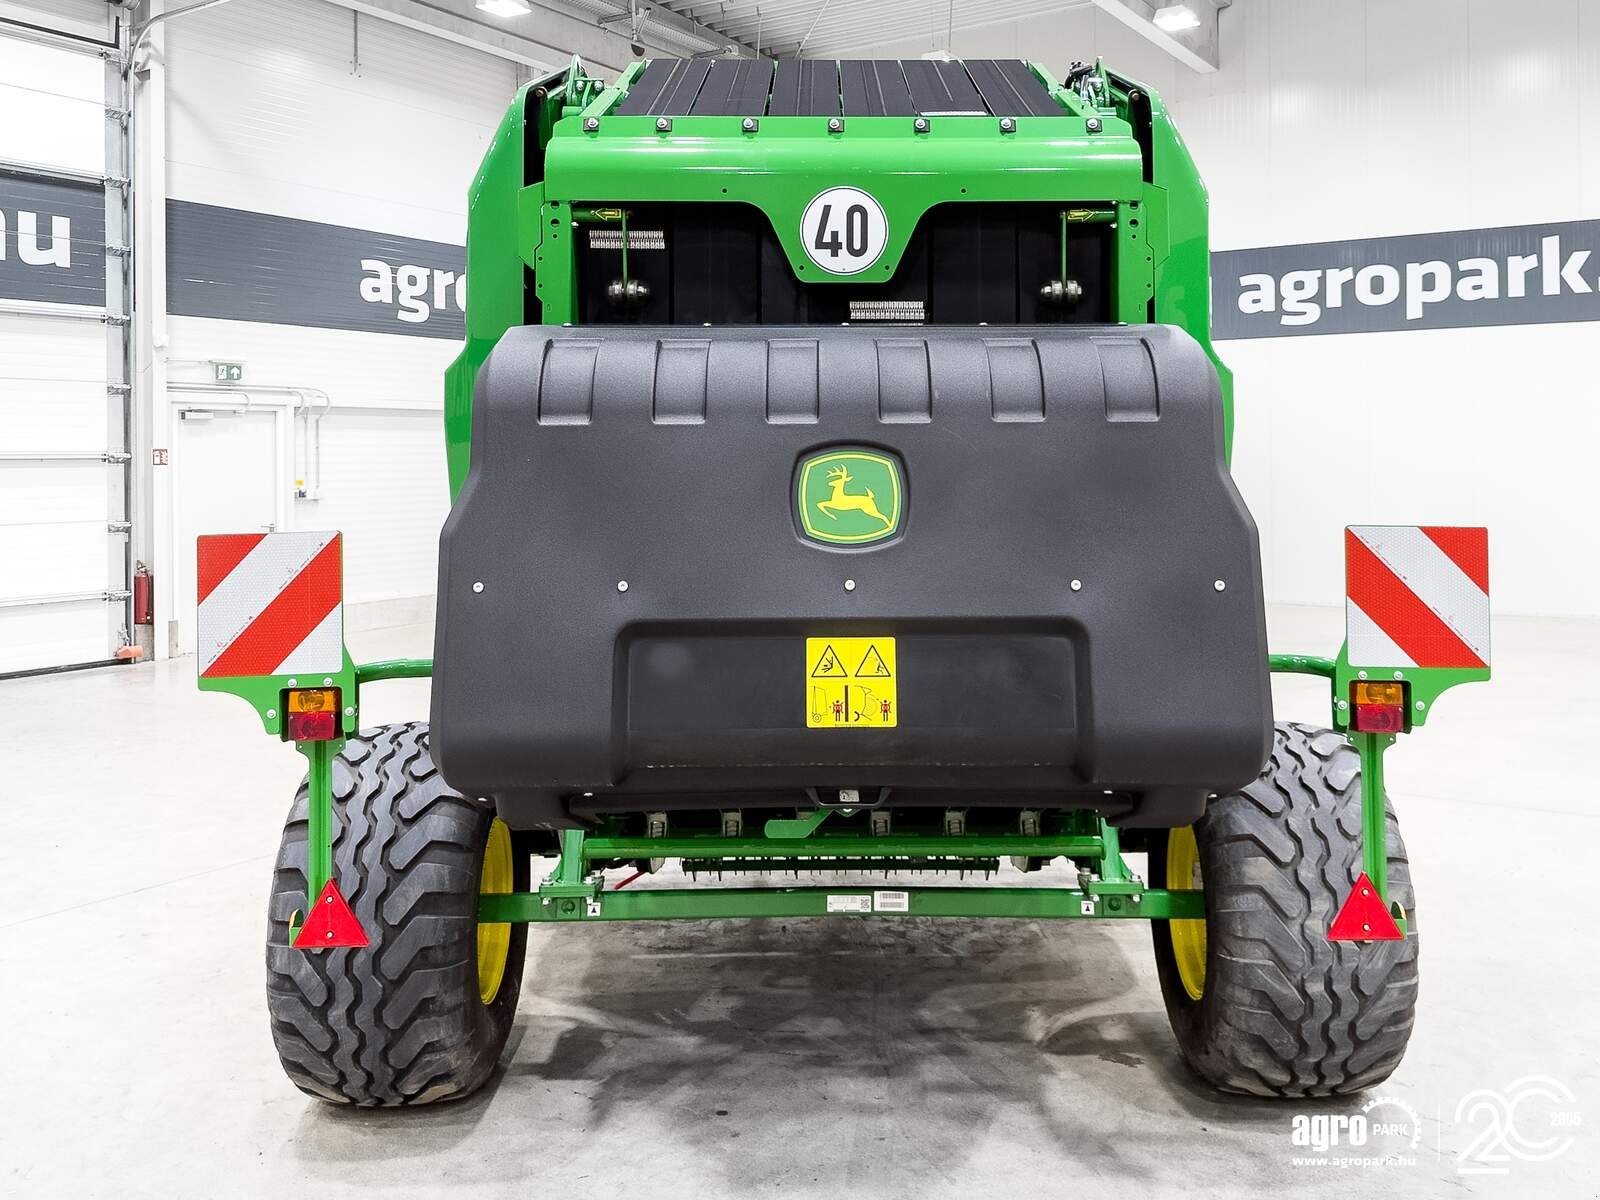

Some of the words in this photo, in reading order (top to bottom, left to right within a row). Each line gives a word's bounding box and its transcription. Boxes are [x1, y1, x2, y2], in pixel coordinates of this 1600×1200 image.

[0, 209, 70, 268] u
[814, 204, 868, 257] 40
[1238, 234, 1600, 326] agropark
